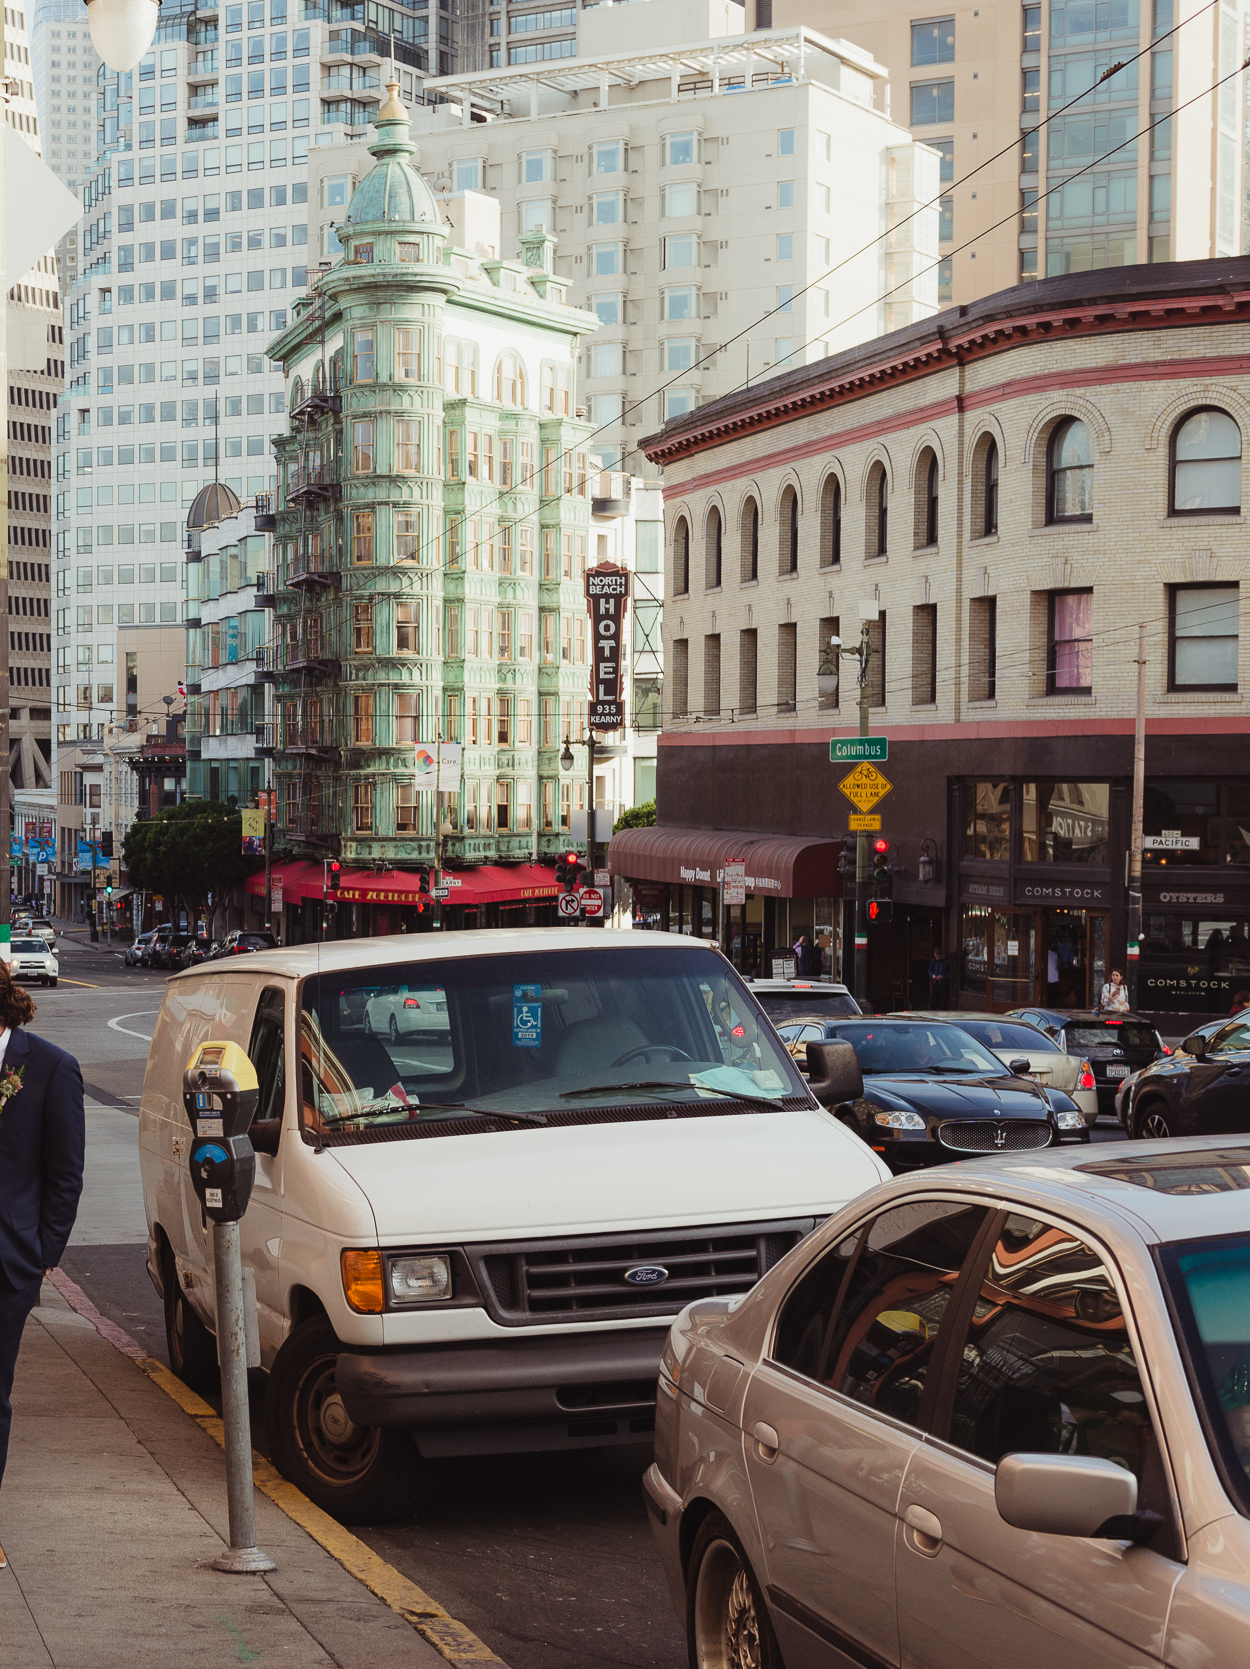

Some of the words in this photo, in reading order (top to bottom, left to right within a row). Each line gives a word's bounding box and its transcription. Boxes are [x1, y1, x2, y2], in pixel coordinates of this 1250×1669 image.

[589, 576, 625, 585] NORTH
[589, 585, 625, 594] BEACH
[598, 598, 616, 700] HOTEL
[596, 705, 617, 713] 935
[590, 715, 622, 723] KEARNY
[836, 743, 881, 756] Columbus
[441, 757, 459, 766] Care.
[841, 782, 868, 790] ALLOWED
[869, 782, 879, 790] USE
[880, 782, 888, 790] OF
[1152, 838, 1191, 847] PACIFIC
[680, 866, 695, 882] Happy
[695, 867, 710, 881] Donut
[337, 889, 362, 899] CAFE
[367, 891, 421, 901] ZOETROPE
[1025, 887, 1102, 898] COMSTOCK
[1159, 892, 1224, 903] OYSTERS
[1147, 979, 1230, 989] COMSTOCK
[635, 1269, 658, 1281] Ford
